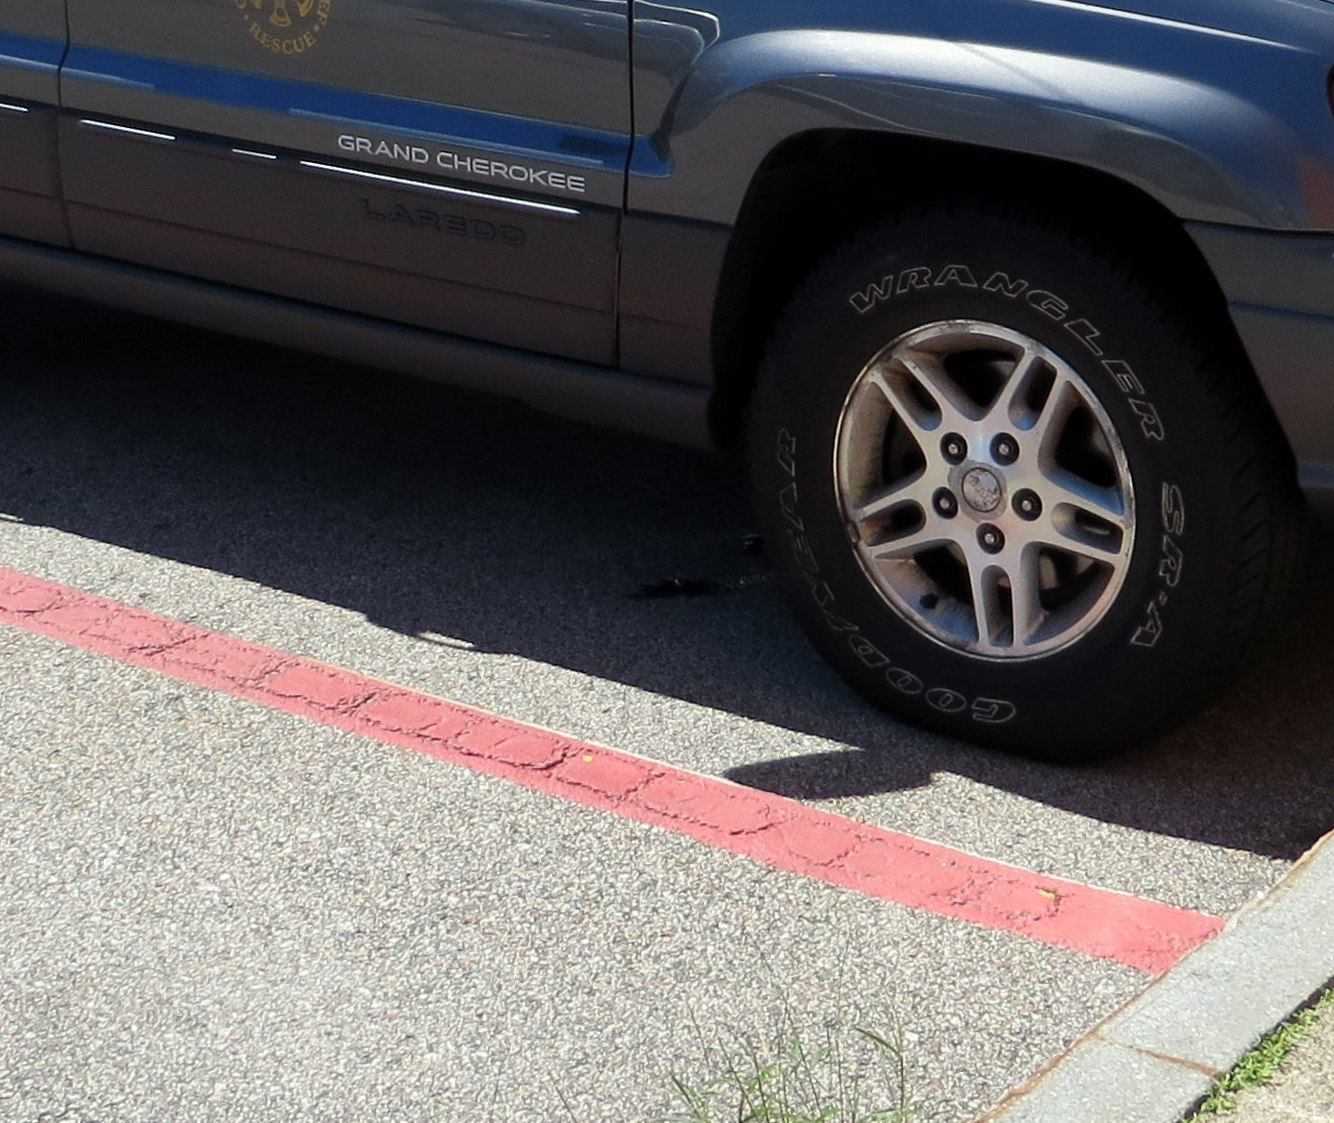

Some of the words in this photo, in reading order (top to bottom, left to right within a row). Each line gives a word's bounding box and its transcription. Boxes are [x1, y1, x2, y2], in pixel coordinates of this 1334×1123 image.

[248, 22, 317, 55] RESCUE
[337, 133, 430, 164] GRAND
[436, 151, 586, 194] CHEROKEE
[360, 197, 528, 247] LAREDO
[849, 264, 1165, 442] WRANGLER
[776, 427, 1017, 724] GOODYEAR
